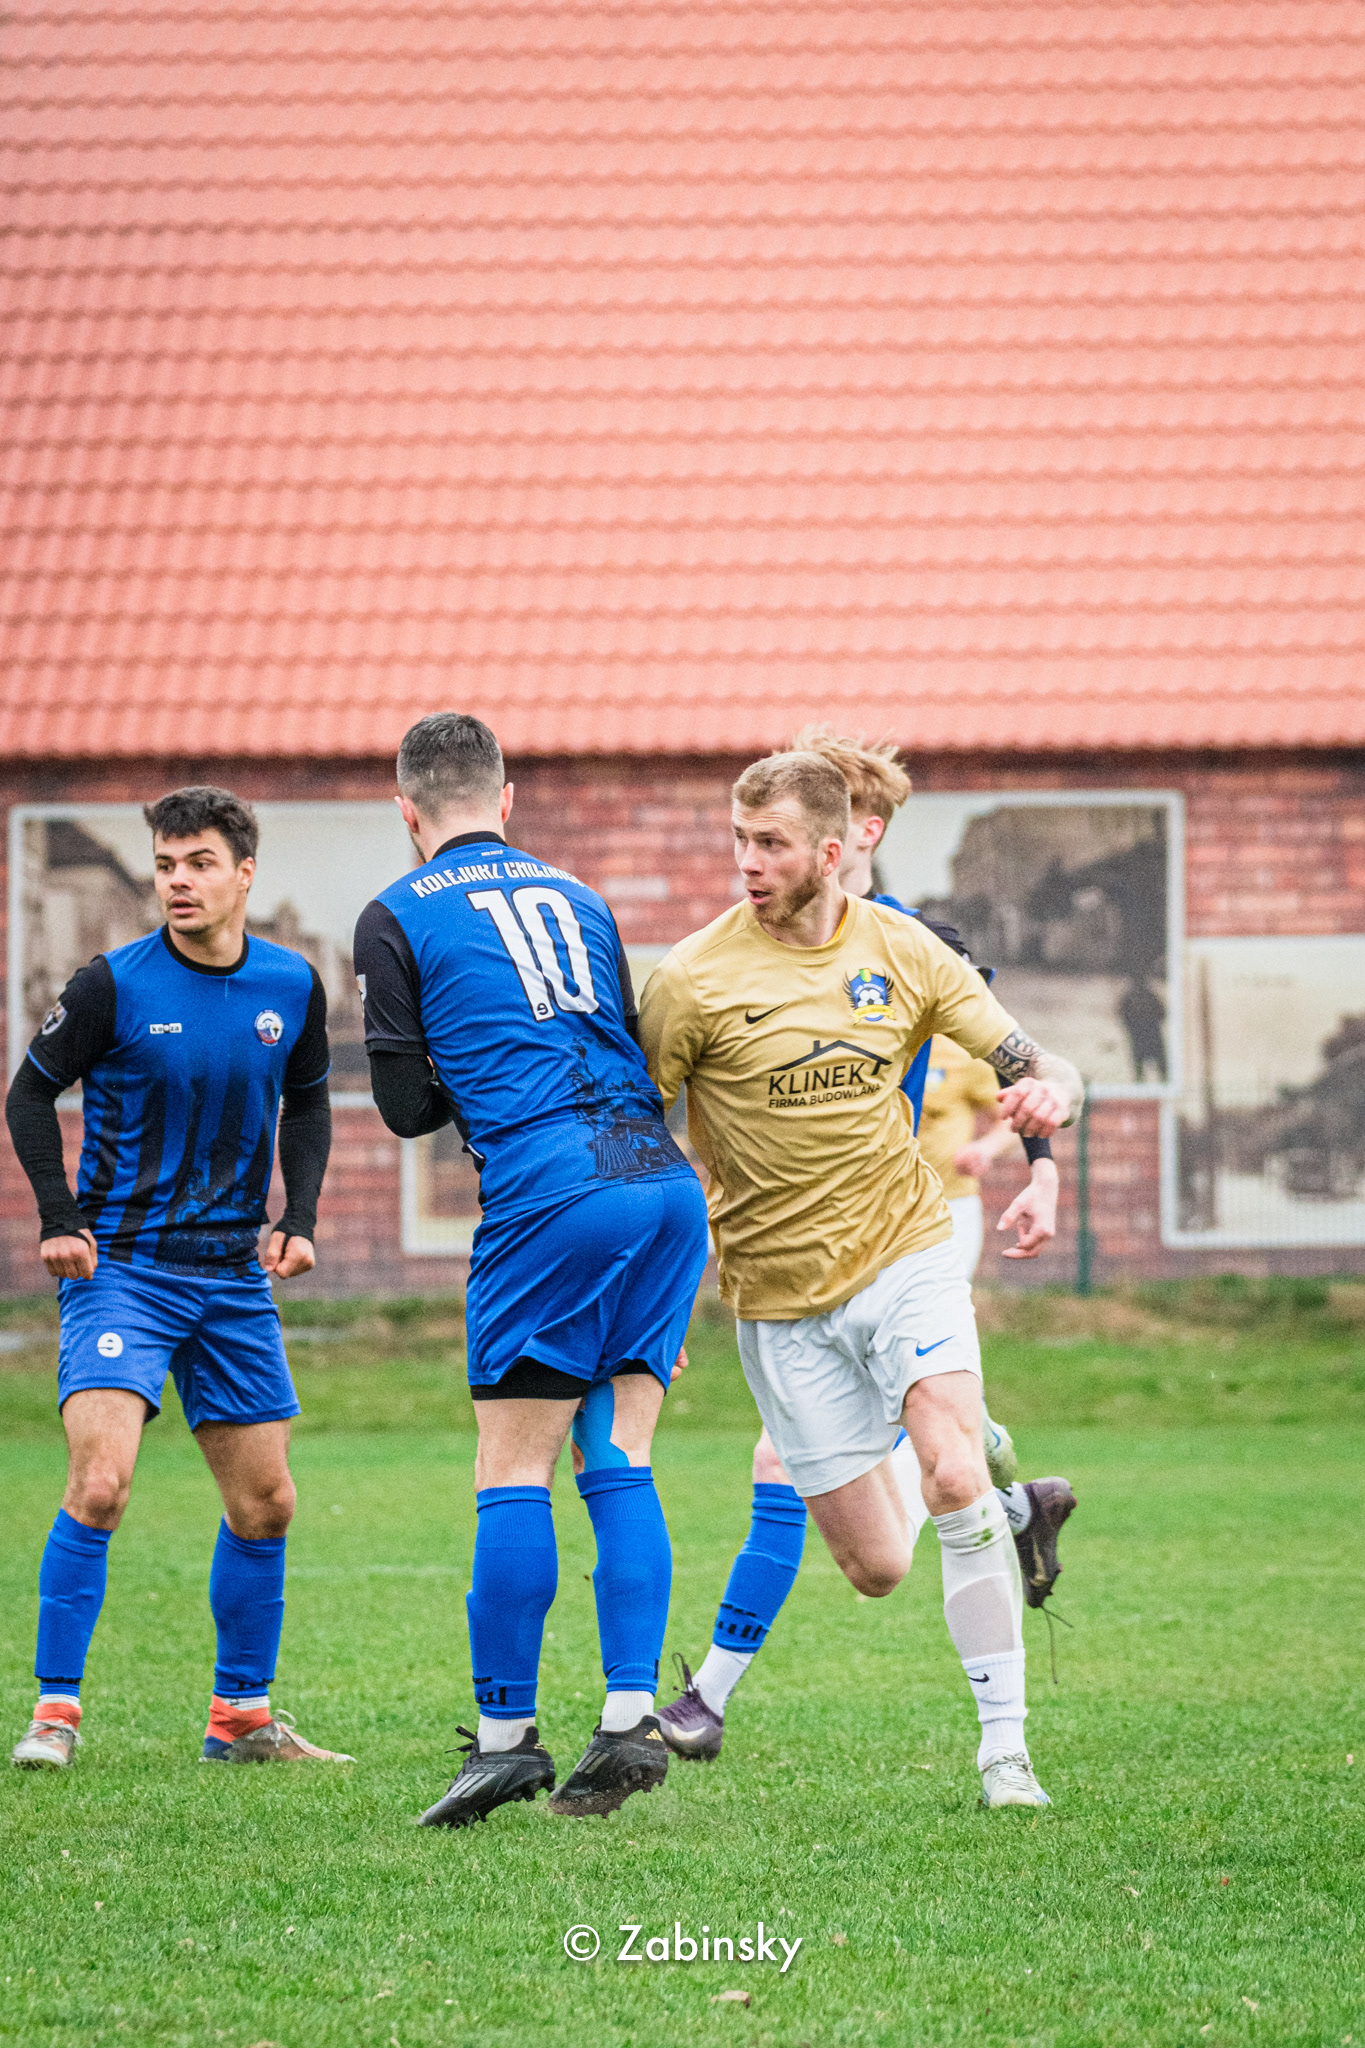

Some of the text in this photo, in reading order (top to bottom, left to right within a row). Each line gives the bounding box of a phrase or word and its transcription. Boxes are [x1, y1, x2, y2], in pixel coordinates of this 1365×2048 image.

[410, 861, 585, 899] KOLEJARZ CHOJNIC
[465, 885, 600, 1022] 10
[768, 1062, 866, 1096] KLINEK
[768, 1084, 881, 1109] FIRMA BUDOWLANA
